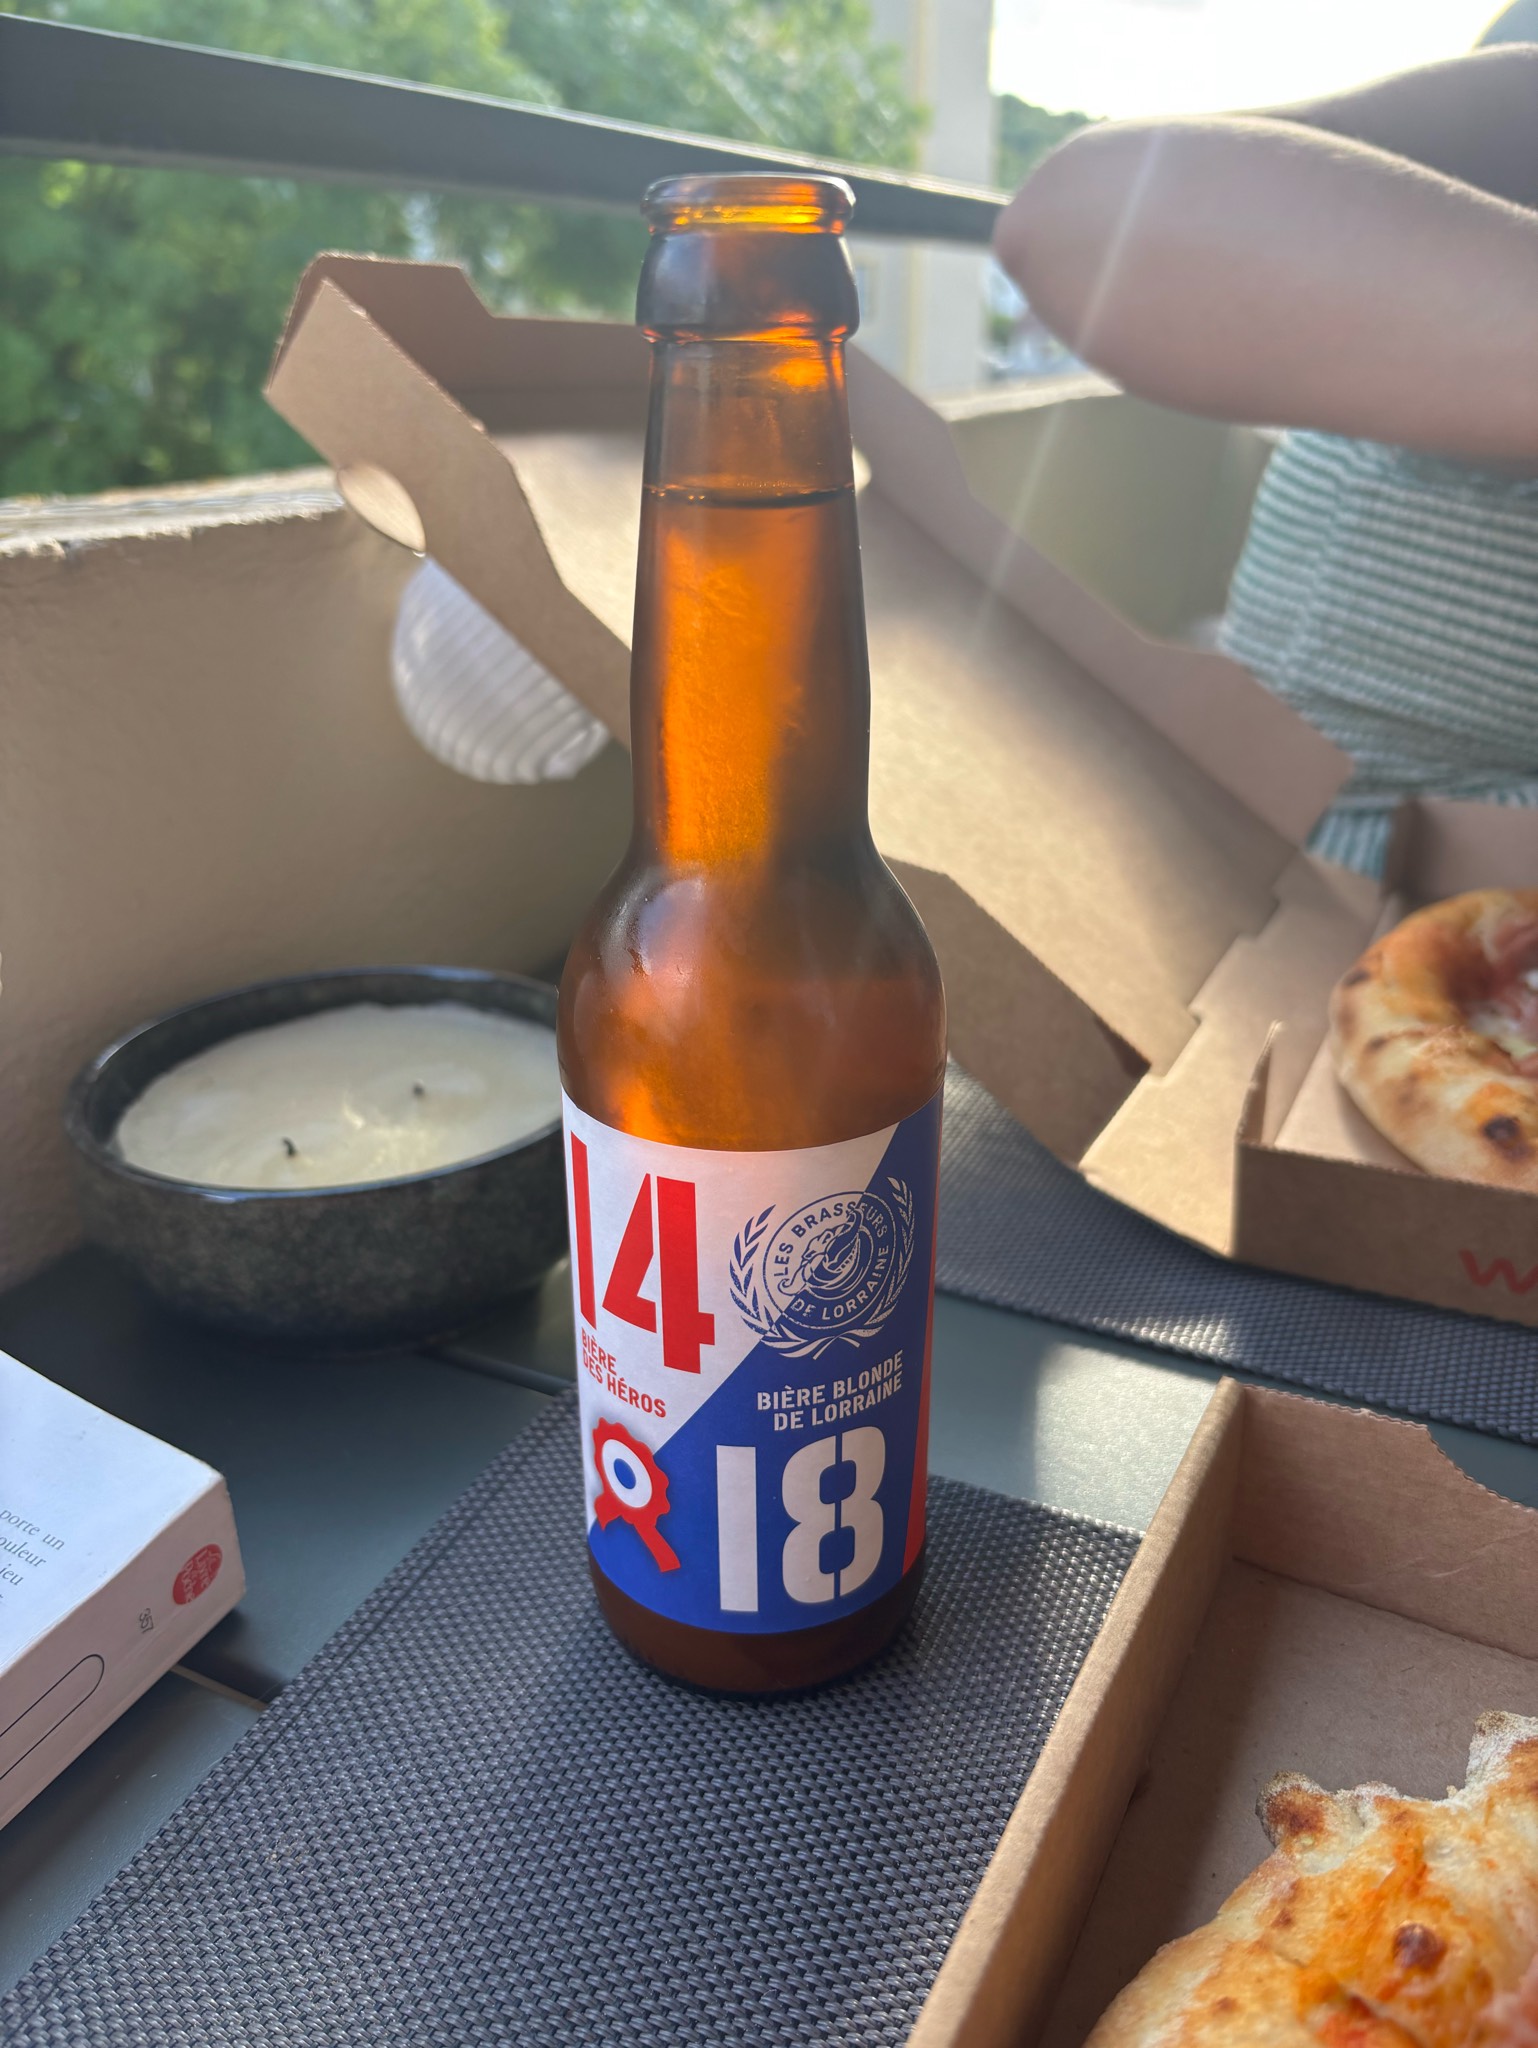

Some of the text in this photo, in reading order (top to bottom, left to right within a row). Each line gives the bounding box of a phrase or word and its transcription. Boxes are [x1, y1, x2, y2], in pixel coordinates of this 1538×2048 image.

[571, 1131, 715, 1374] 14
[774, 1201, 888, 1277] LES BRASSEURS
[791, 1245, 889, 1320] DE LORRAINE
[582, 1327, 617, 1376] BIÈRE
[583, 1347, 667, 1418] DES HÉROS
[757, 1350, 903, 1410] BIÈRE BLONDE
[774, 1370, 903, 1431] DE LORRAINE
[42, 1533, 65, 1551] un
[716, 1426, 886, 1612] 18
[139, 1607, 154, 1634] 357
